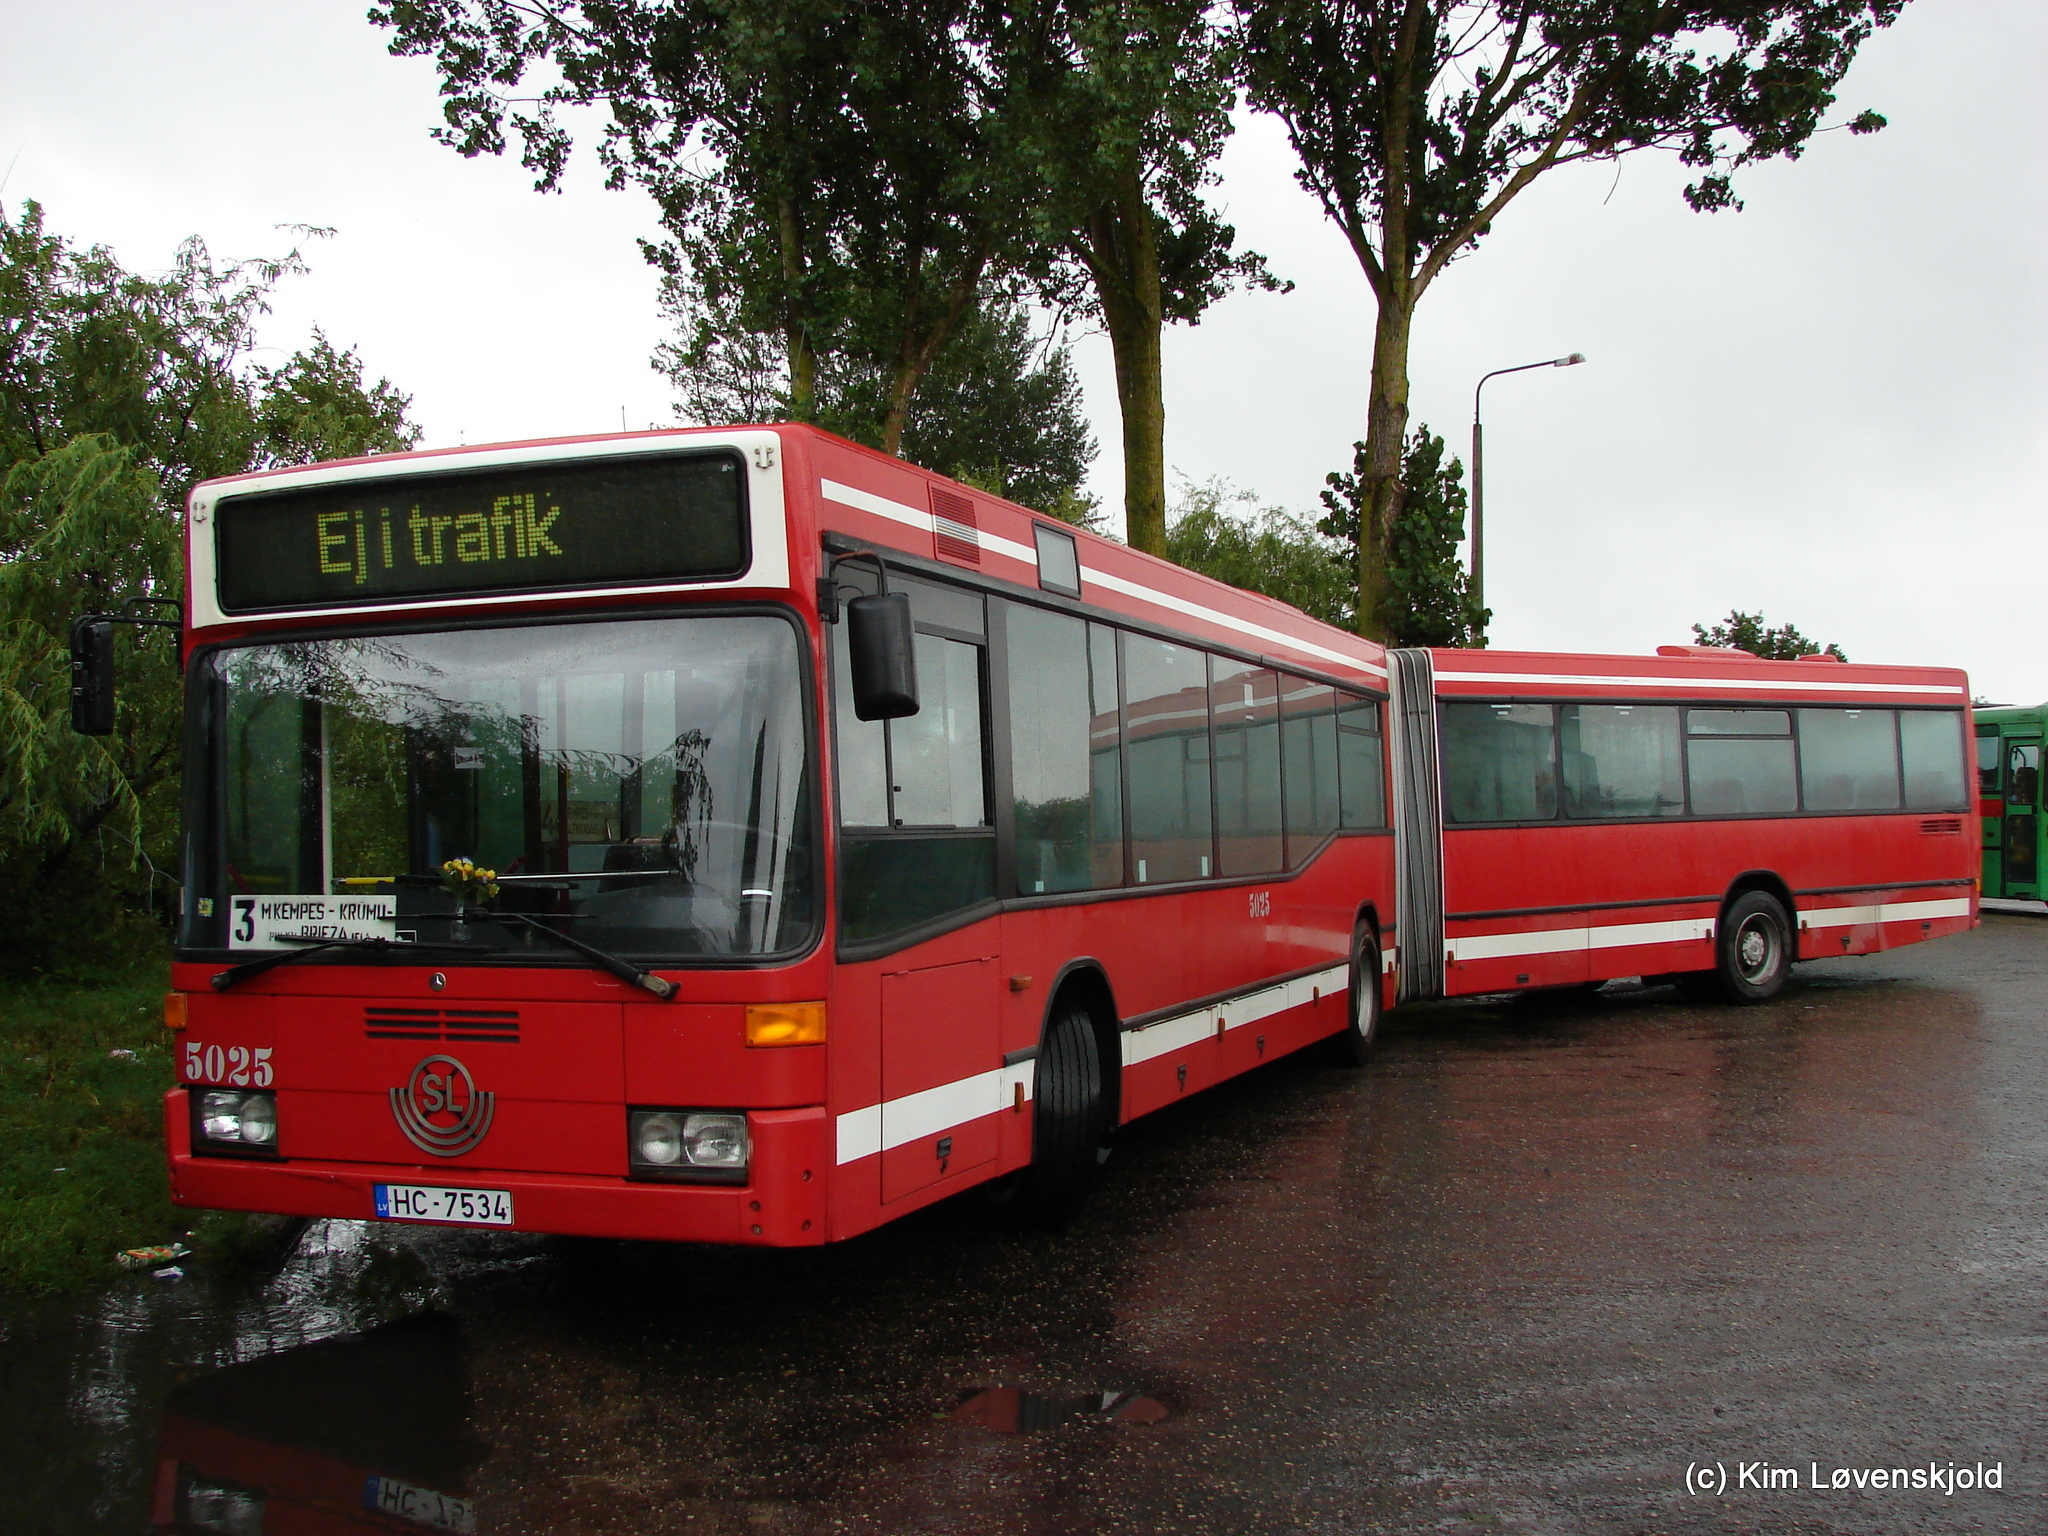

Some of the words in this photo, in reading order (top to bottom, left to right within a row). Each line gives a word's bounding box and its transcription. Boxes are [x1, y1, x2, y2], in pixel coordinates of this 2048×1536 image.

[318, 510, 367, 585] Ej
[381, 507, 394, 568] i
[408, 493, 563, 566] trafik
[235, 900, 256, 942] 3
[1249, 891, 1270, 919] 5025
[185, 1041, 274, 1088] 5025
[421, 1073, 464, 1112] SL
[378, 1203, 388, 1211] LV
[394, 1188, 507, 1220] HC-7534
